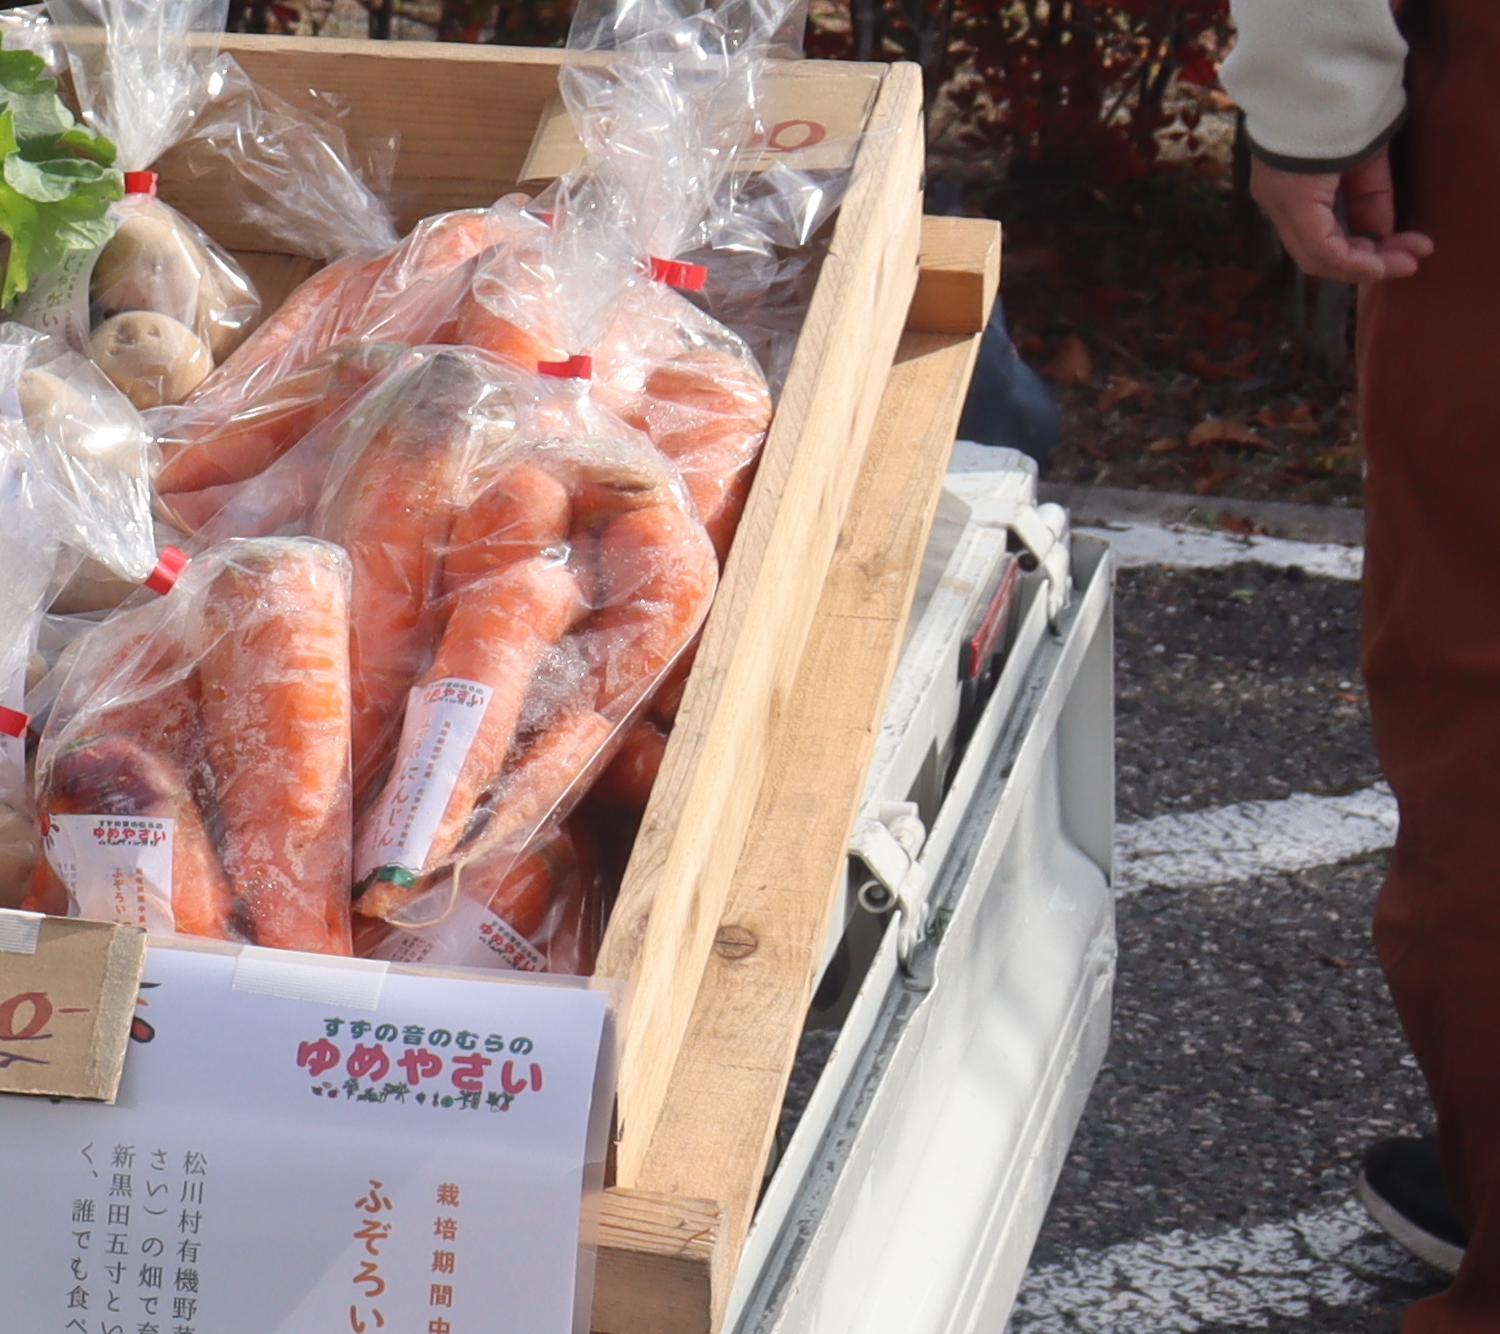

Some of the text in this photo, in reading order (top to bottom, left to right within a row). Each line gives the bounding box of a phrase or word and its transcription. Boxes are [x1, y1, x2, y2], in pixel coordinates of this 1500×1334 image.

[112, 867, 132, 926] ふぞろい
[323, 1017, 533, 1055] すずの音のむらの
[297, 1037, 543, 1095] ゆめやさい
